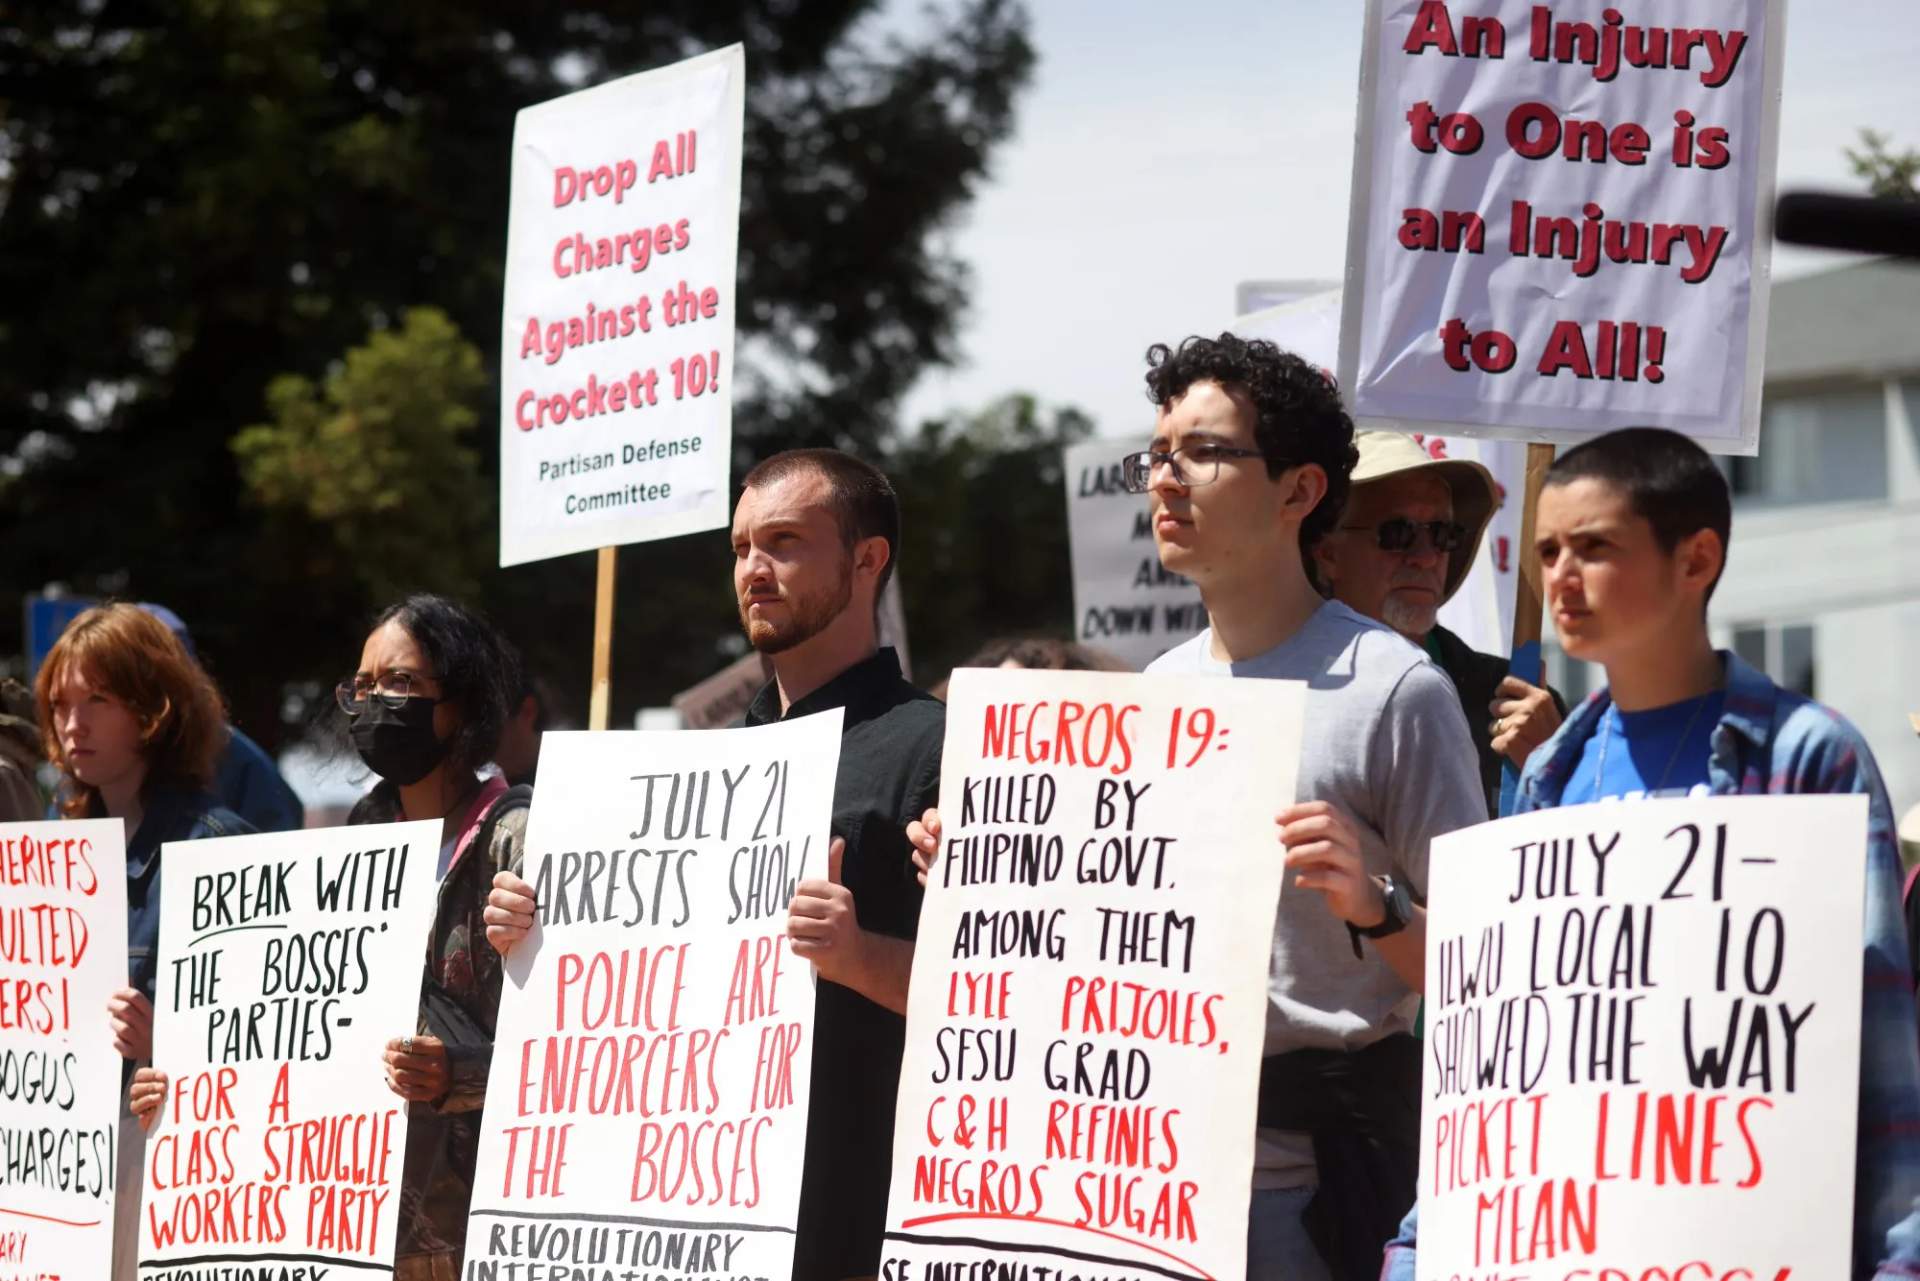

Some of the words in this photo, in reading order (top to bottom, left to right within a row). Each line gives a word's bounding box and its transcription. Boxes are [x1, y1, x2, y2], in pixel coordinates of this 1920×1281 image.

[1403, 0, 1505, 58] An
[1529, 5, 1748, 87] Injury
[553, 158, 637, 208] Drop
[648, 130, 697, 183] All
[1406, 101, 1484, 155] to
[1505, 102, 1650, 165] One
[1672, 110, 1730, 169] is
[553, 218, 690, 279] Charges
[1398, 207, 1486, 254] an
[1509, 200, 1729, 284] Injury
[520, 294, 651, 365] Against
[662, 281, 718, 326] the
[1440, 318, 1517, 373] to
[1537, 320, 1666, 384] All!
[515, 368, 658, 431] Crockett
[670, 351, 720, 399] 10!
[539, 451, 614, 481] Partisan
[623, 436, 702, 466] Defense
[565, 483, 671, 515] Committee
[1083, 605, 1154, 639] DOWN
[982, 701, 1142, 775] NEGROS
[1166, 707, 1230, 769] 19:
[629, 765, 750, 841] JULY
[752, 759, 788, 842] 21
[960, 774, 1056, 828] KILLED
[1095, 779, 1152, 831] BY
[192, 861, 297, 932] BREAK
[317, 844, 409, 912] WITH
[535, 849, 697, 928] ARRESTS
[727, 834, 811, 924] SHOW
[943, 833, 1064, 889] FILIPINO
[1077, 836, 1177, 890] GOVT.
[1509, 832, 1620, 903] JULY
[1661, 823, 1776, 901] 21-
[0, 904, 88, 968] ULTED
[172, 949, 223, 1012] THE
[262, 923, 388, 996] BOSSES'
[952, 909, 1066, 962] AMONG
[1096, 907, 1195, 973] THEM
[1440, 922, 1504, 1011] ILWU
[1530, 904, 1658, 993] LOCAL
[1715, 907, 1785, 996] 10
[0, 977, 69, 1042] ERS!
[556, 943, 691, 1031] POLICE
[724, 935, 786, 1027] ARE
[947, 971, 1014, 1020] LYLE
[1061, 976, 1229, 1054] PRIJOLES,
[208, 999, 352, 1063] PARTIES-
[518, 1028, 729, 1118] ENFORCERS
[750, 1022, 801, 1114] FOR
[931, 1027, 1016, 1084] SFSU
[1045, 1040, 1151, 1101] GRAD
[1432, 995, 1550, 1099] SHOWED
[1566, 994, 1646, 1085] THE
[1684, 997, 1817, 1093] WAY
[0, 1049, 76, 1112] OGUS
[175, 1066, 238, 1124] FOR
[269, 1062, 290, 1123] A
[152, 1125, 240, 1191] CLASS
[264, 1110, 398, 1187] STRUGGLE
[502, 1123, 574, 1199] THE
[630, 1116, 772, 1209] BOSSES
[1046, 1099, 1181, 1174] REFINES
[1434, 1092, 1549, 1197] PICKET
[1595, 1091, 1774, 1188] LINES
[149, 1182, 289, 1250] WORKERS
[306, 1184, 389, 1257] PARTY
[913, 1156, 1049, 1216] NEGROS
[1074, 1171, 1199, 1243] SUGAR
[1474, 1176, 1598, 1268] MEAN
[488, 1223, 744, 1274] REVOLUTIONARY
